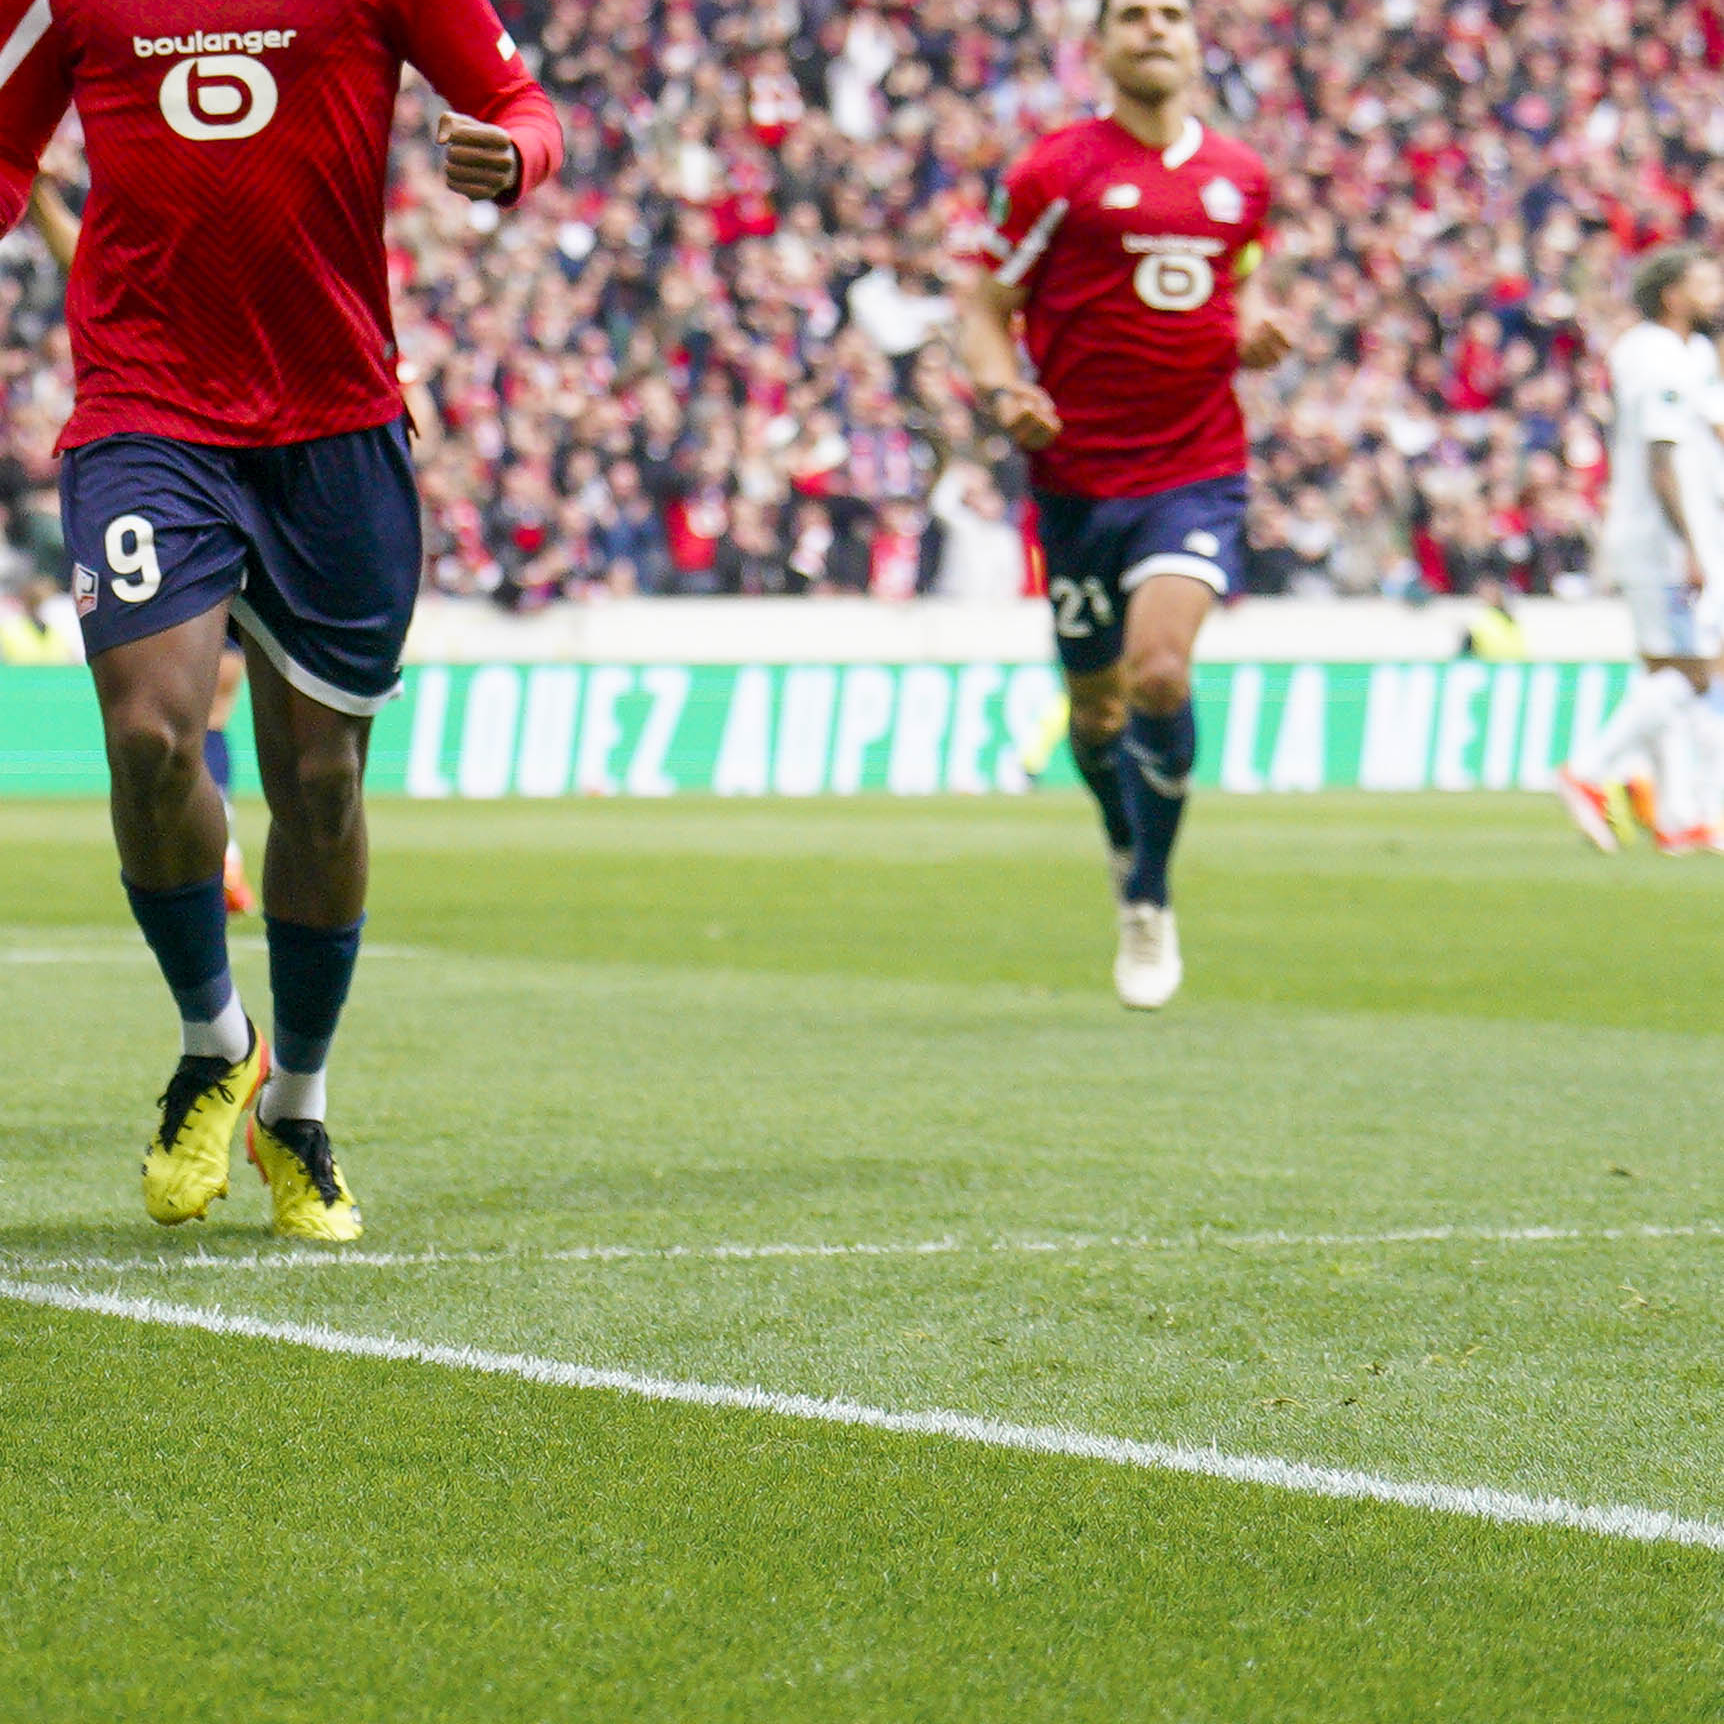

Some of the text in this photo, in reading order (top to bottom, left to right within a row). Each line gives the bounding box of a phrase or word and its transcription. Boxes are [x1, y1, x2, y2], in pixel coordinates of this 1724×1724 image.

[133, 30, 296, 58] boulanger
[104, 514, 163, 603] 9
[1051, 576, 1112, 639] 21
[406, 665, 692, 798] LOUEZ
[1220, 663, 1328, 793] LA
